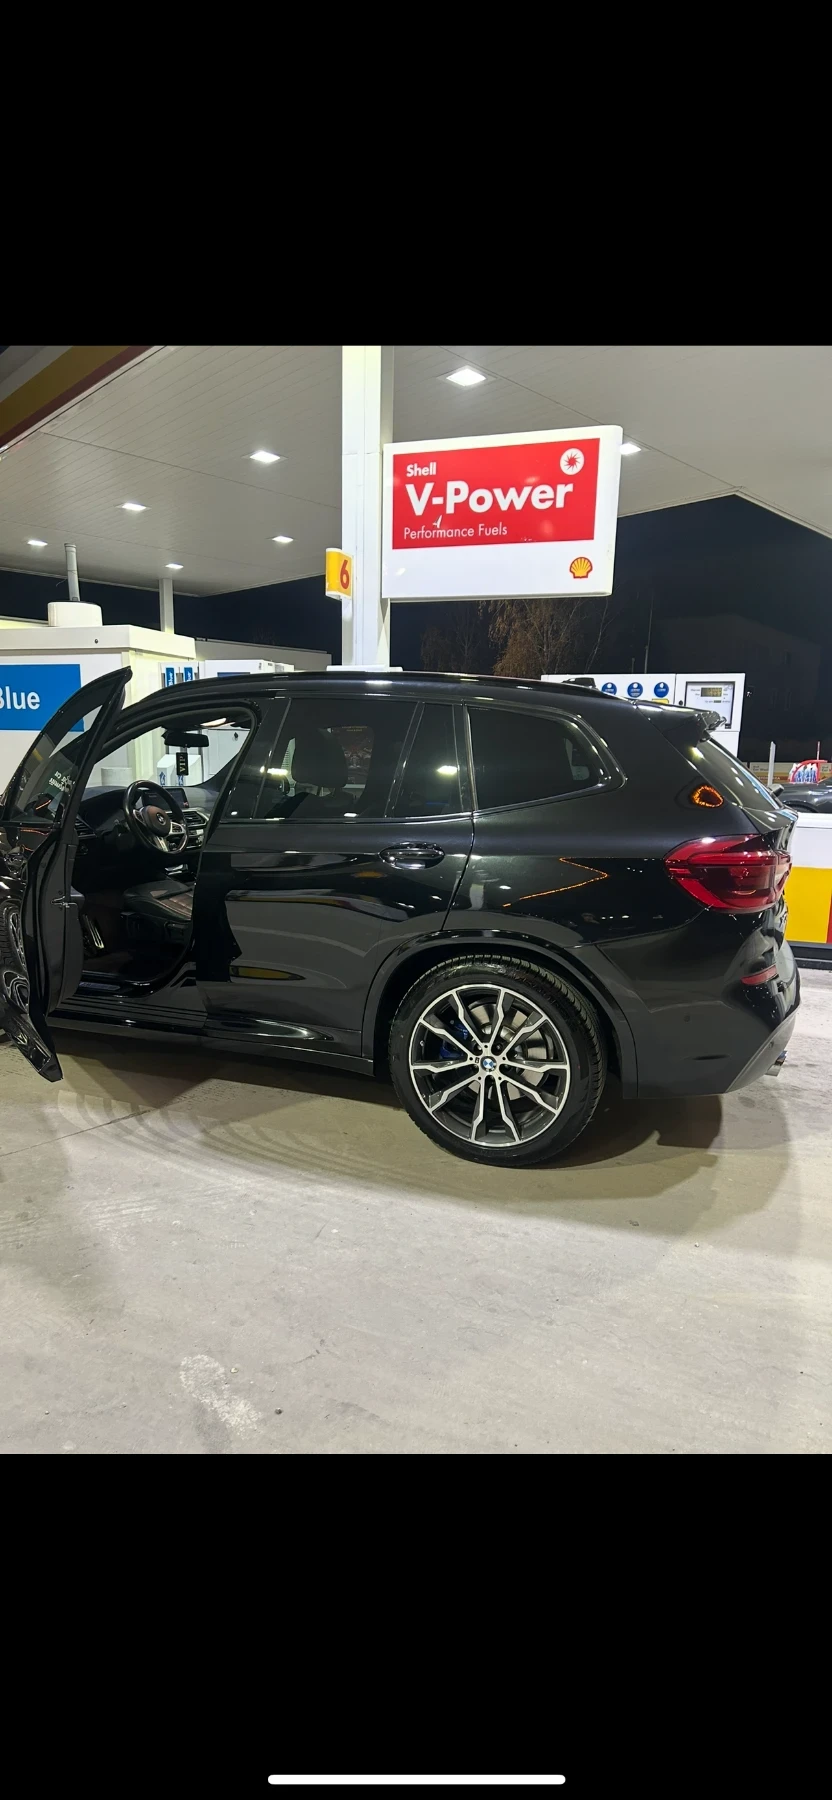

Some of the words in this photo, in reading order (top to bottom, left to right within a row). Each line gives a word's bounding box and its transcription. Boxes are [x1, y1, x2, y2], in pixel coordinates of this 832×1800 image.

[405, 462, 437, 478] Shell
[405, 480, 574, 517] V-Power
[403, 525, 475, 540] Performance
[478, 522, 508, 536] Fuels
[340, 560, 350, 590] 6
